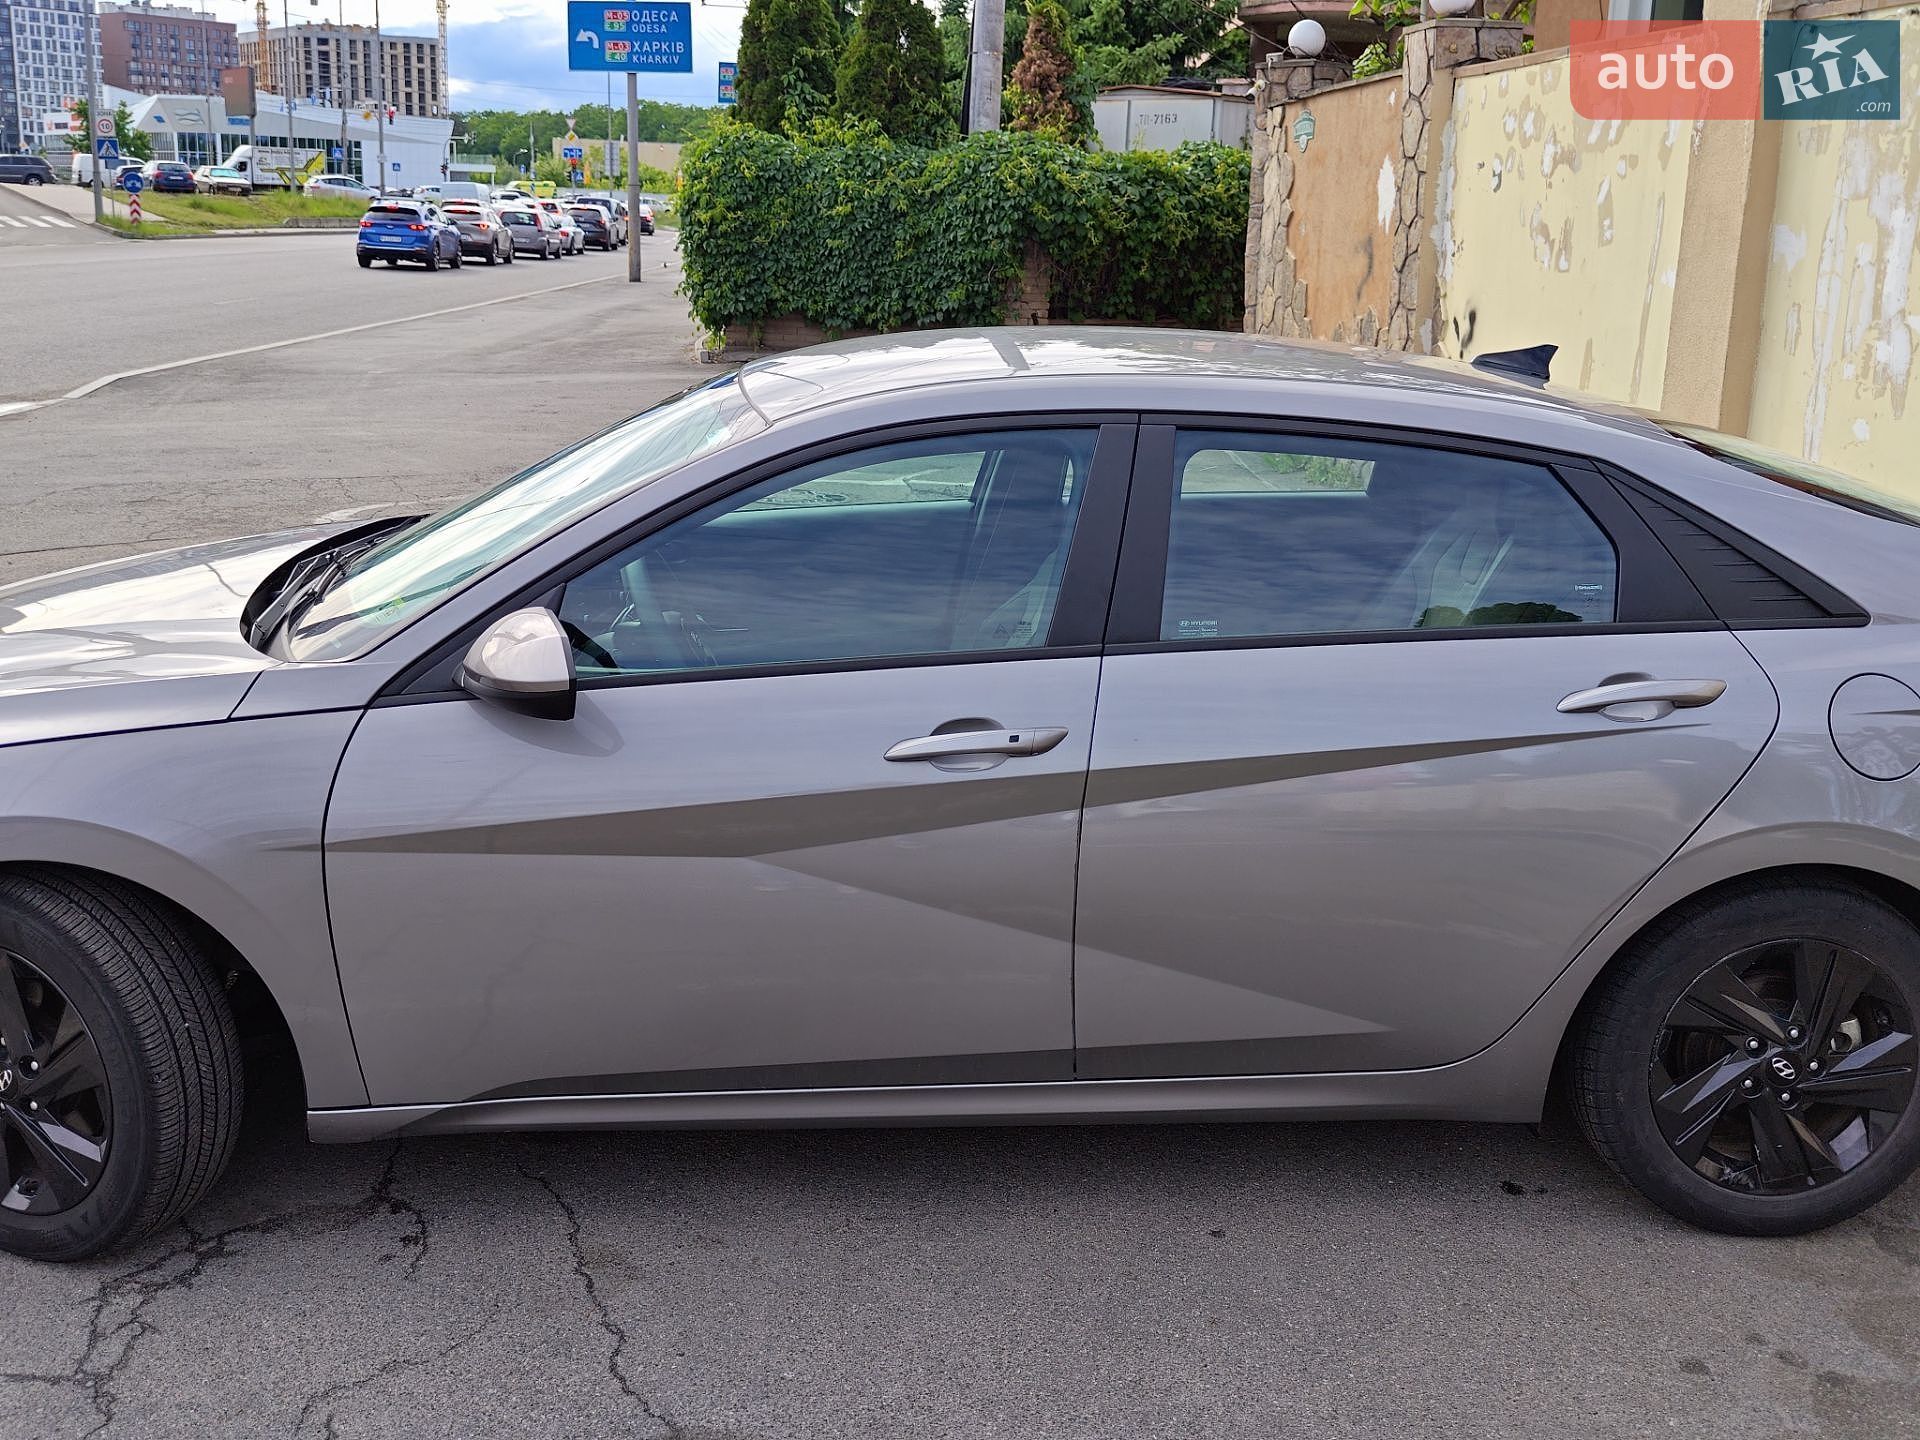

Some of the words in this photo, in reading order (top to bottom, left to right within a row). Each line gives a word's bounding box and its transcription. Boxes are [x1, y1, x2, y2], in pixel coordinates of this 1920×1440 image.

[631, 10, 679, 22] ОДЕСА
[632, 23, 667, 33] ODESA
[632, 41, 684, 53] ХАРКІВ
[632, 54, 680, 64] KHARKIV
